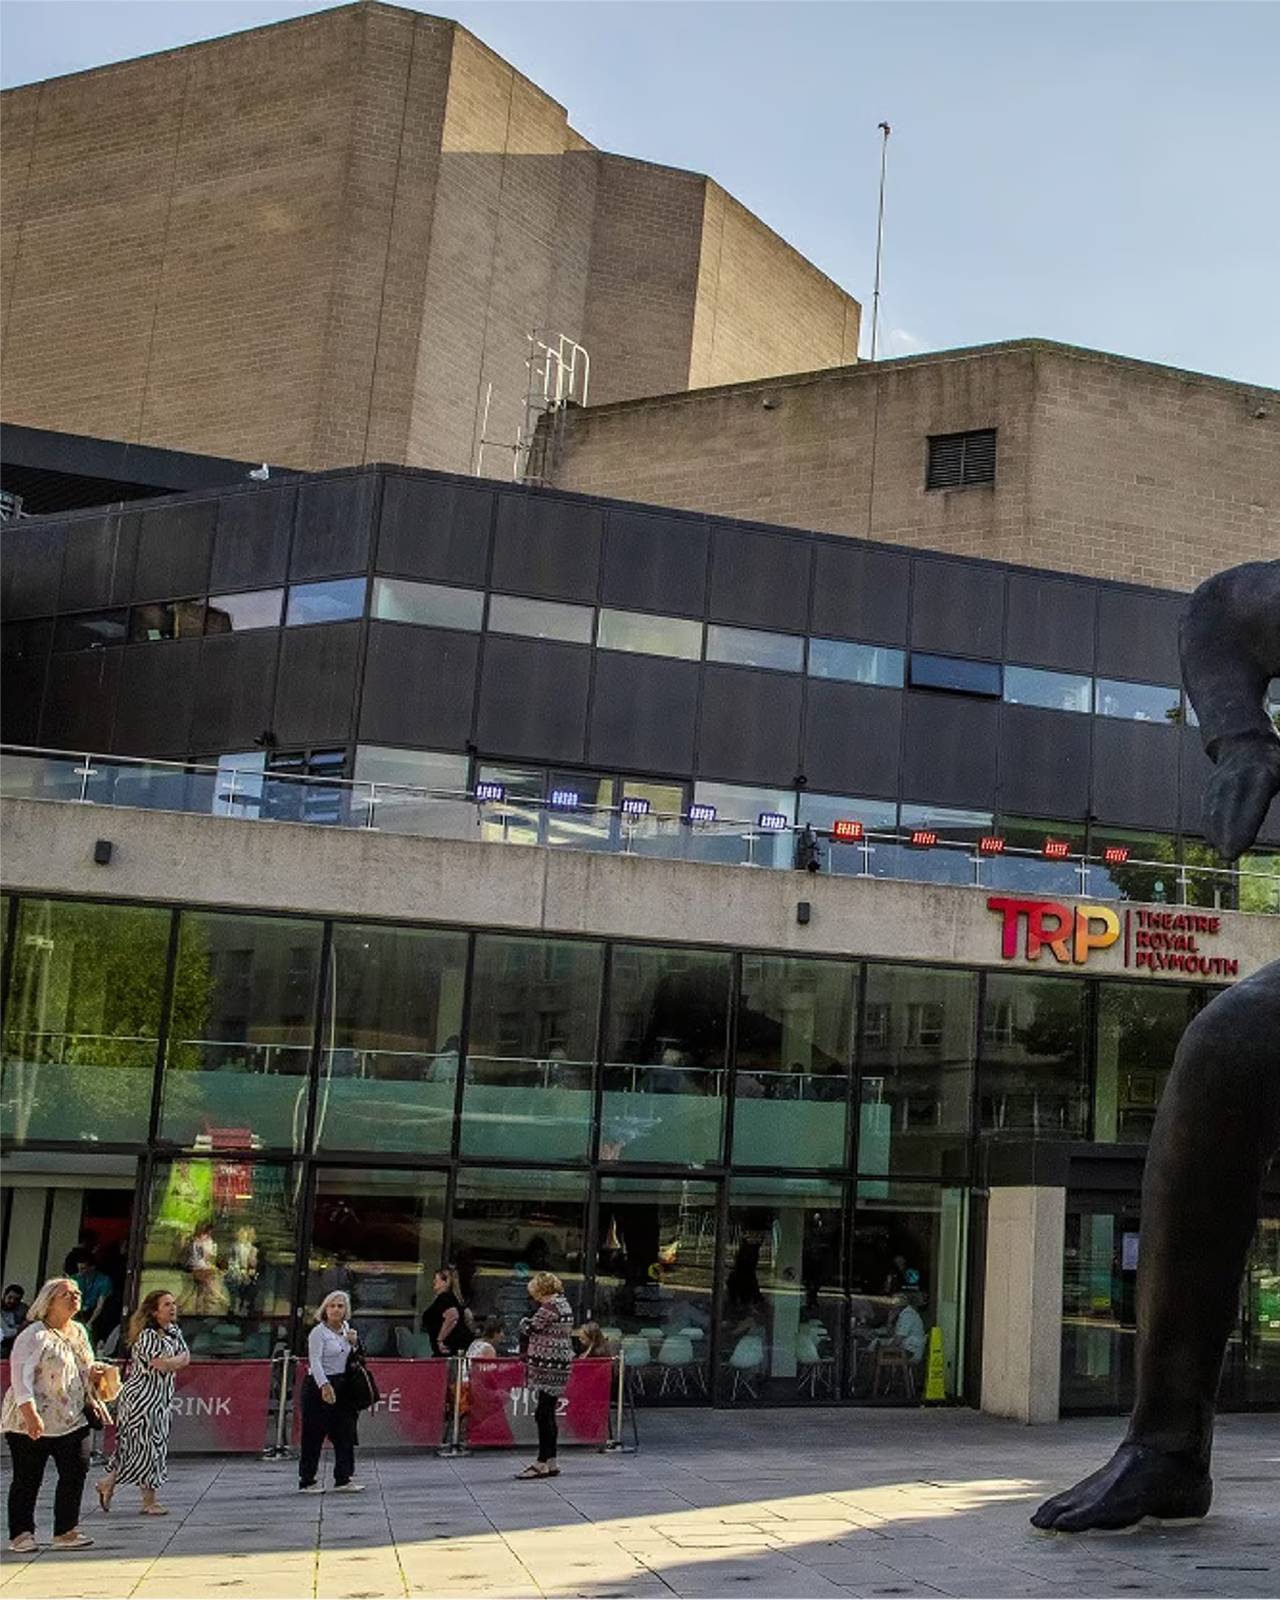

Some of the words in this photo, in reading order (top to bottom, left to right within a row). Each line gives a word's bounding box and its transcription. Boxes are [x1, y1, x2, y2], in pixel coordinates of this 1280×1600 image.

[987, 896, 1120, 964] TRP
[1136, 910, 1221, 934] THEATRE
[1136, 930, 1199, 952] ROYAL
[1136, 951, 1238, 976] PLYMOUTH
[170, 1397, 231, 1416] RINK
